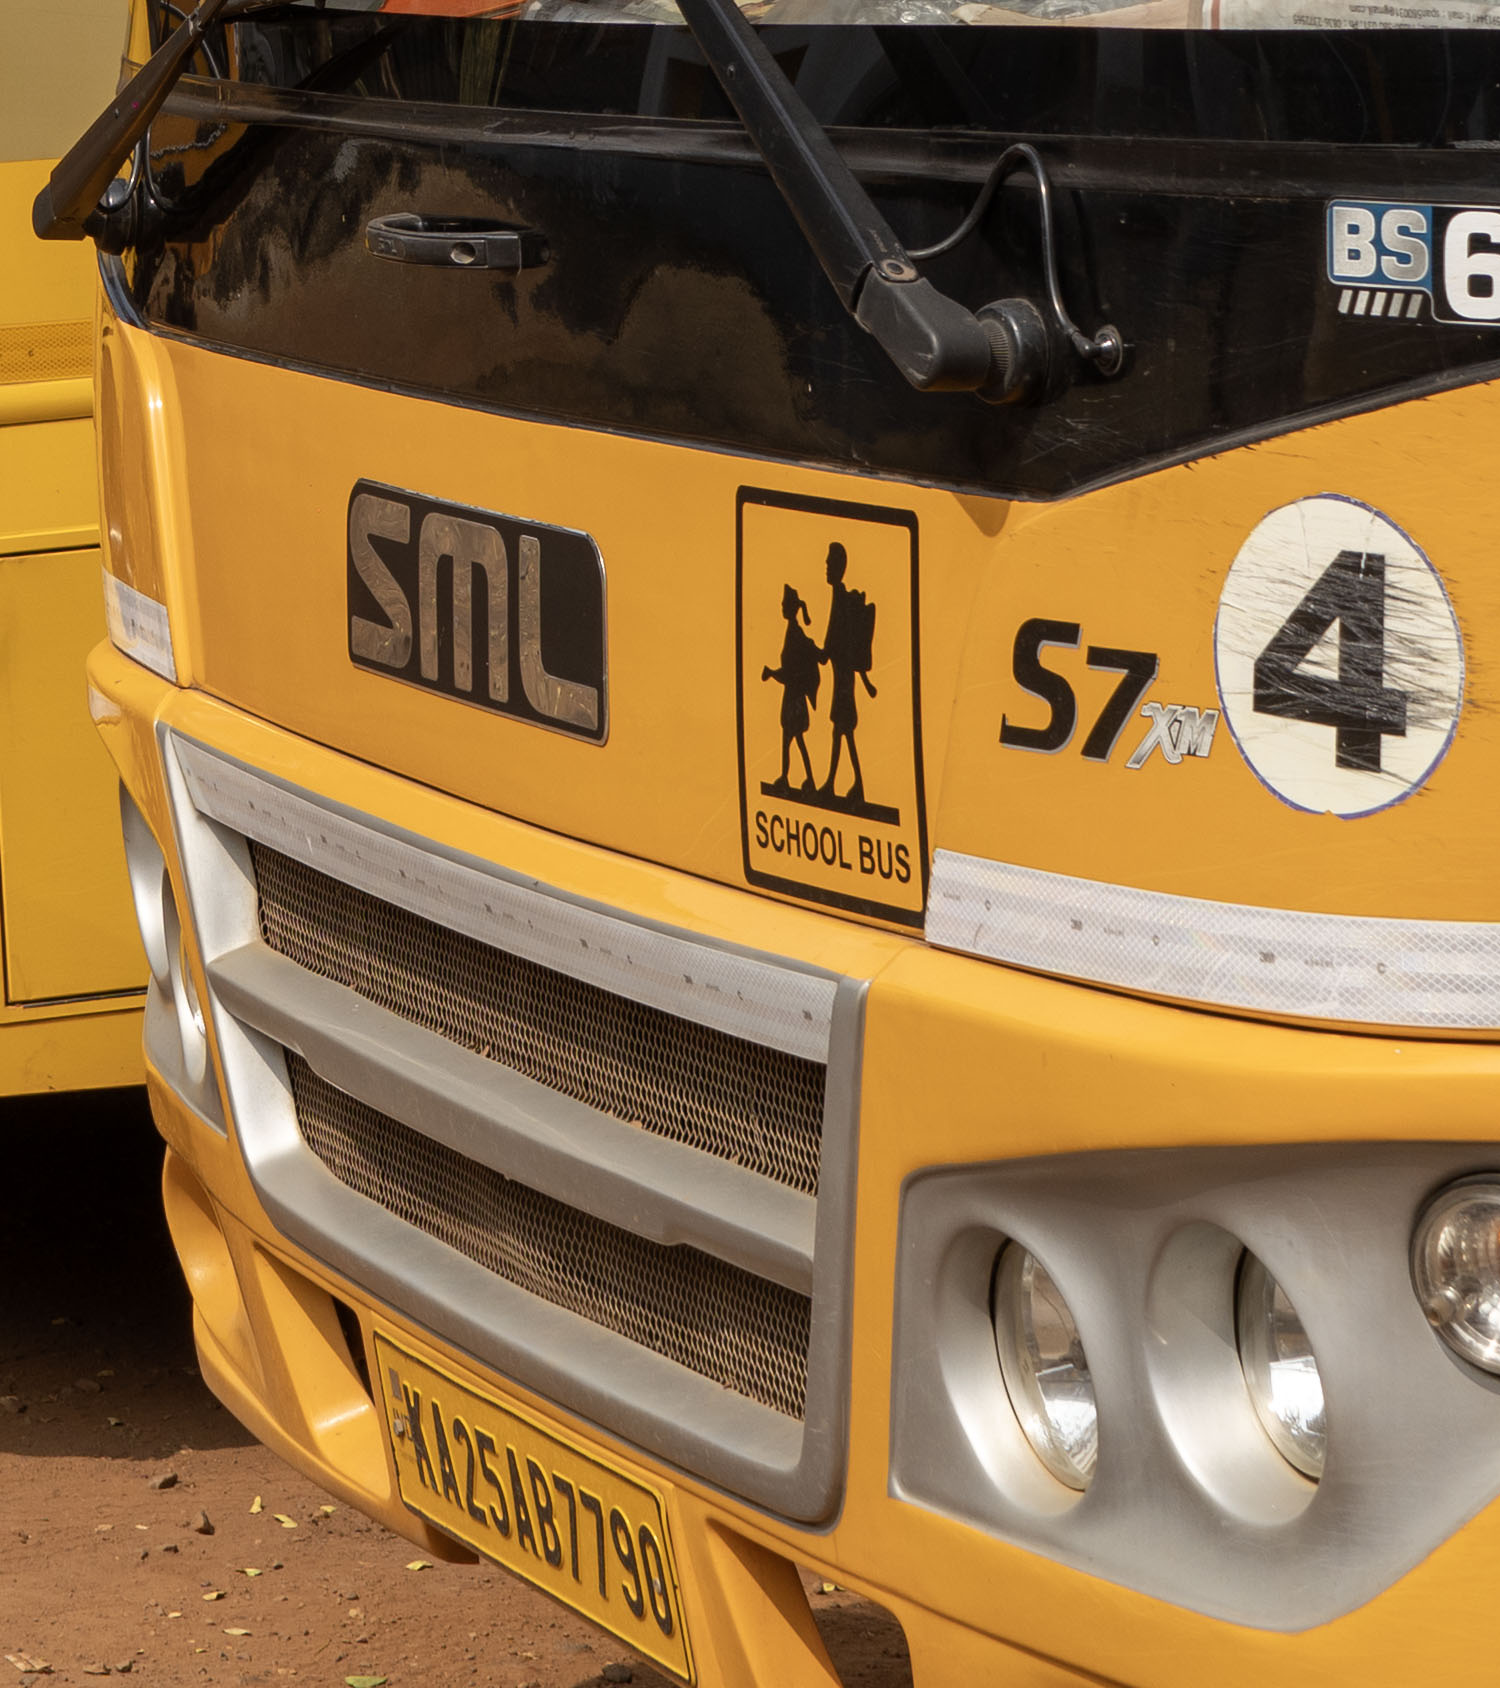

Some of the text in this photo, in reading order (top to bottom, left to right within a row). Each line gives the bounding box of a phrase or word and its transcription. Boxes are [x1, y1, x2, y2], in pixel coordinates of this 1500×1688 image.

[350, 492, 600, 731] SML
[1000, 617, 1160, 762] S7
[1253, 550, 1407, 773] 4
[756, 813, 912, 885] SCHOOL BUS
[403, 1384, 673, 1636] KA25AB7790
